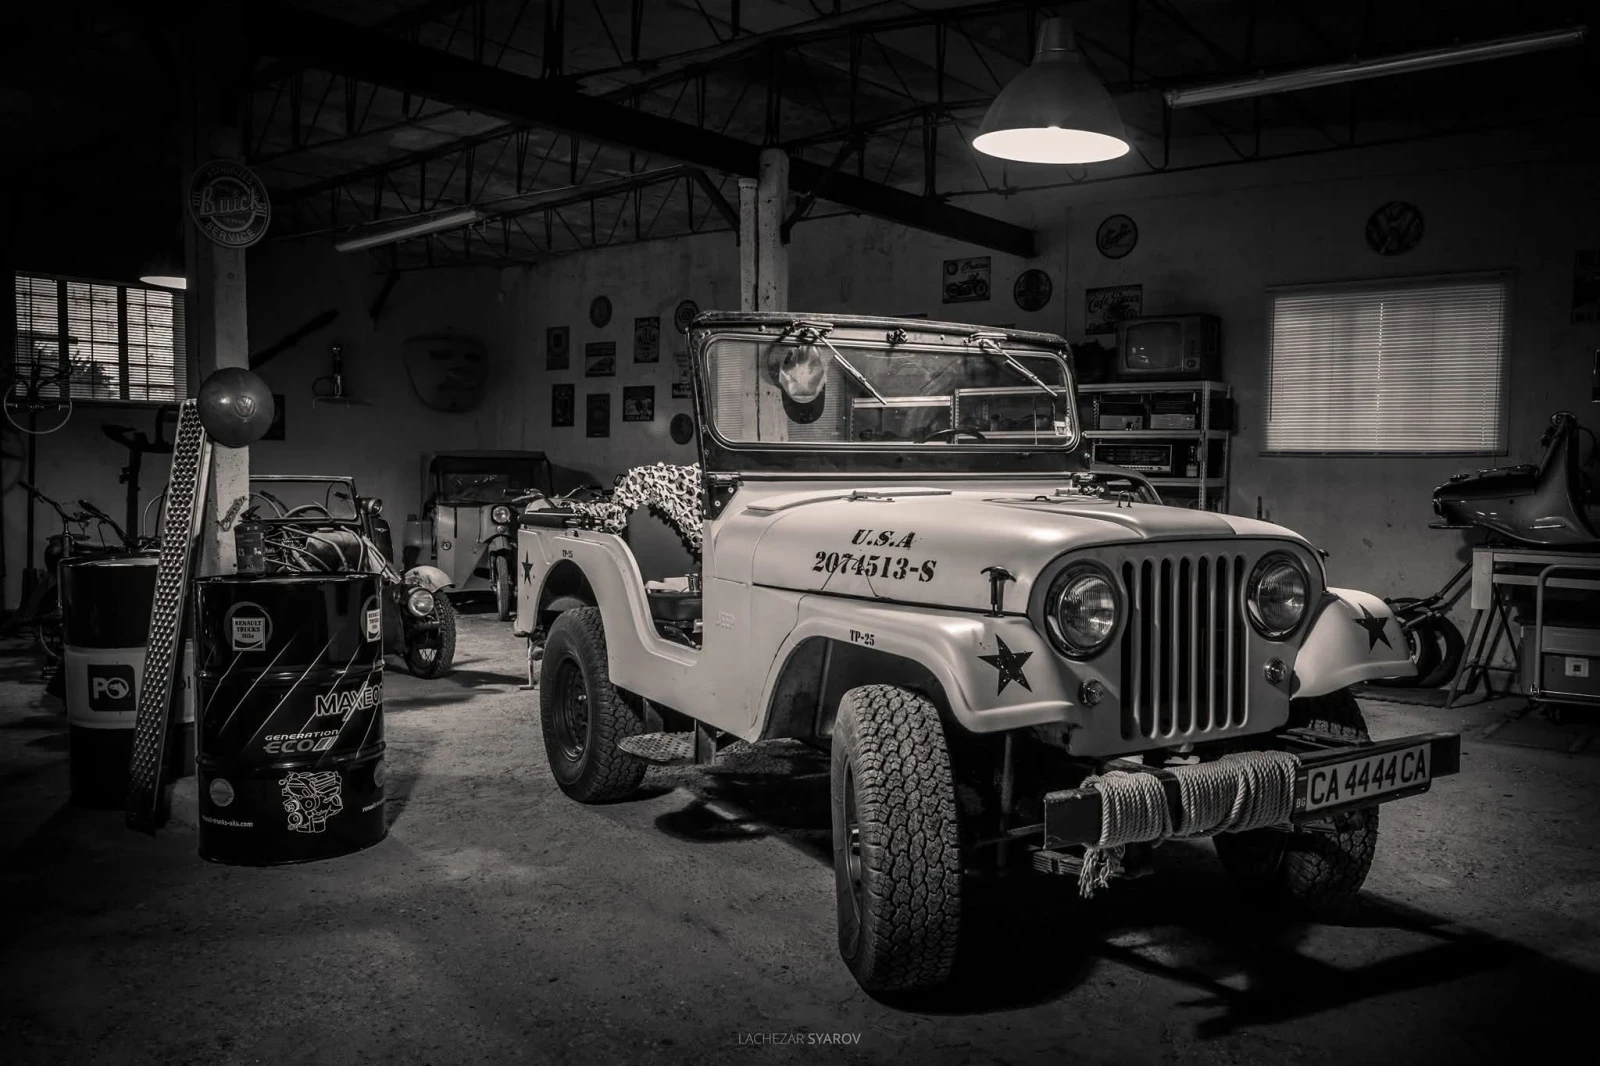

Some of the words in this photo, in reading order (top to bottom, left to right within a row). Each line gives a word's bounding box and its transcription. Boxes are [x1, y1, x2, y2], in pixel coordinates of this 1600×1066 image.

[200, 185, 264, 216] Buick
[205, 220, 256, 242] SERVICE
[851, 529, 917, 549] U.S.A
[812, 550, 938, 583] 2074513-S
[849, 629, 876, 647] TP-25
[264, 729, 340, 741] GENERATION
[1311, 769, 1339, 805] CA
[1345, 755, 1398, 796] 4444
[1401, 749, 1426, 782] CA
[1296, 797, 1307, 809] BG
